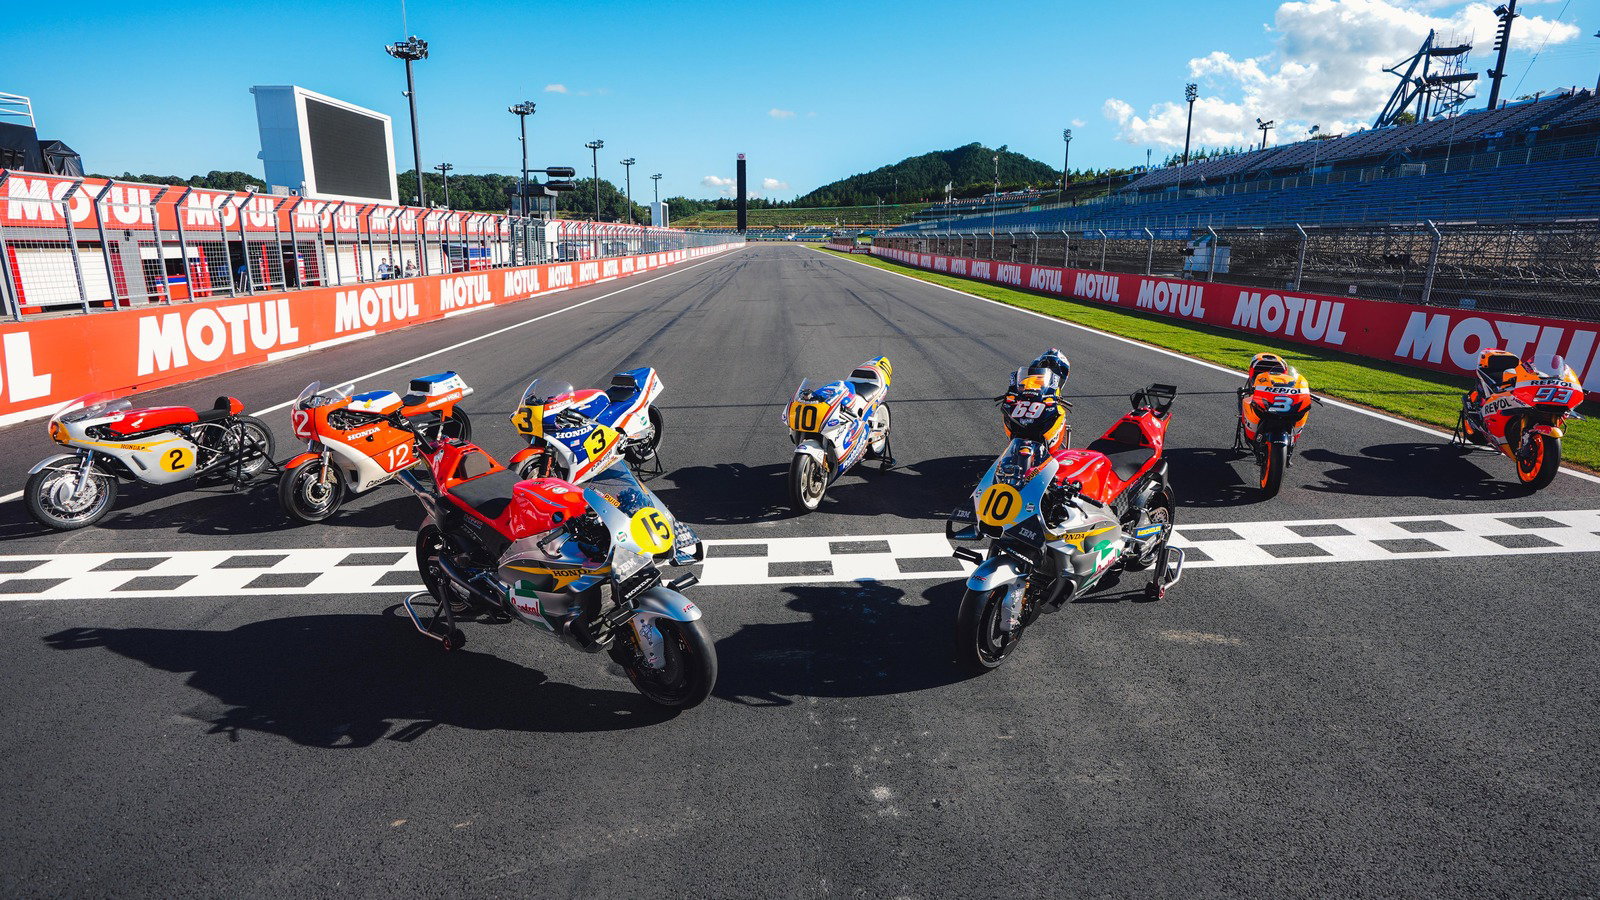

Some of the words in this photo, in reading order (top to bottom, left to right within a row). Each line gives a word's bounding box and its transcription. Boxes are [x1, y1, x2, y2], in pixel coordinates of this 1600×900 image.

[8, 177, 159, 224] MOTUL
[187, 193, 279, 227] MOTUL
[504, 269, 540, 297] MOTUL
[548, 265, 574, 288] MOTUL
[971, 261, 990, 279] MOTUL
[997, 264, 1021, 285] MOTUL
[1029, 268, 1062, 293] MOTUL
[440, 274, 491, 310] MOTUL
[1074, 272, 1119, 303] MOTUL
[1136, 279, 1205, 319] MOTUL
[335, 283, 419, 333] MOTUL
[1231, 291, 1346, 346] MOTUL
[138, 299, 299, 376] MOTUL
[0, 331, 51, 403] L
[1530, 379, 1572, 388] REPSOL
[1533, 386, 1574, 403] 93
[1011, 401, 1046, 418] 69
[1268, 396, 1293, 413] 3
[517, 407, 533, 433] 3
[556, 424, 593, 438] HONDA
[794, 405, 817, 431] 10
[347, 426, 380, 441] HONDA
[591, 428, 606, 454] 3
[169, 449, 185, 470] 2
[388, 443, 409, 470] 12
[957, 509, 971, 519] IBM
[983, 488, 1014, 520] 10
[641, 512, 670, 546] 15
[1019, 527, 1037, 540] IBM
[621, 558, 638, 573] IBM
[624, 578, 653, 598] HONDA
